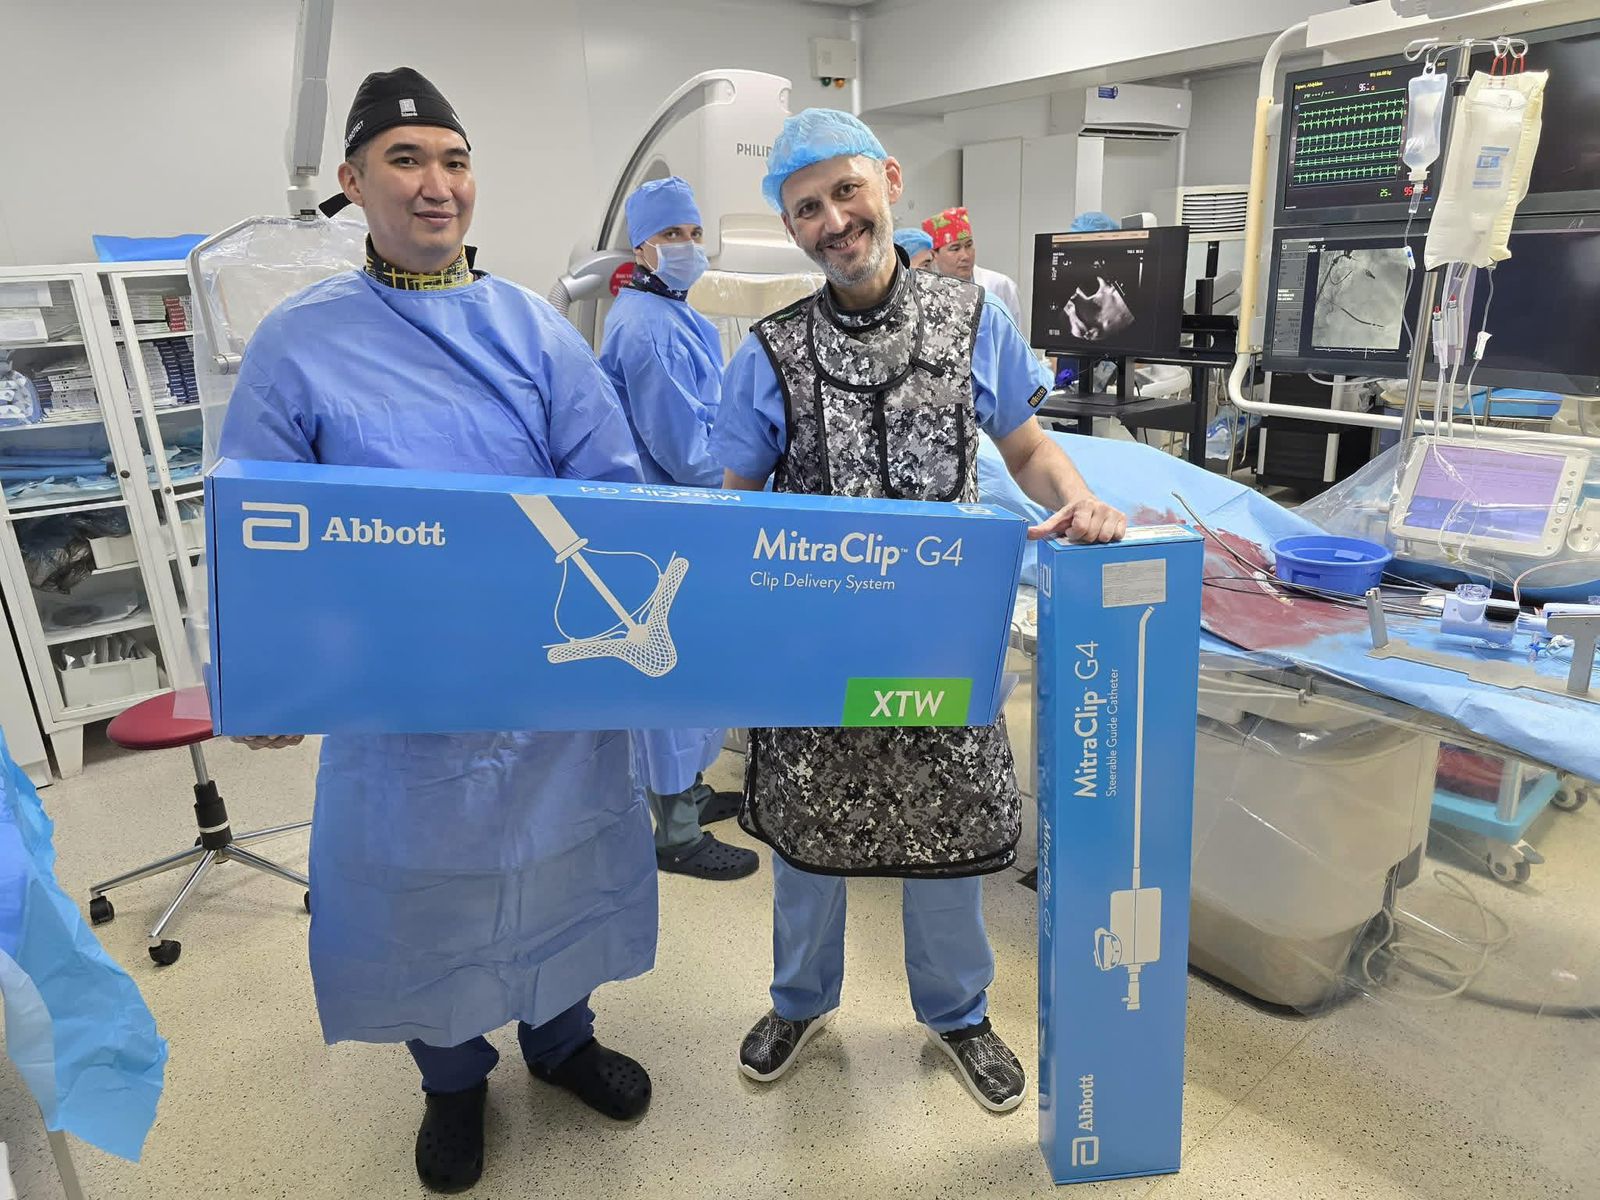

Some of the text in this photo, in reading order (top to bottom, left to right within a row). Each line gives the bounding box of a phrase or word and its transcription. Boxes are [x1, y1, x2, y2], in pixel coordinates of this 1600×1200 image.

[321, 516, 446, 546] Abbott
[915, 535, 964, 567] G4
[750, 571, 896, 594] Clip Delivery System
[1074, 640, 1100, 680] G4
[869, 690, 945, 717] XTW
[1106, 667, 1119, 798] Steerable Guide Catheter
[1078, 1073, 1095, 1132] Abbott
